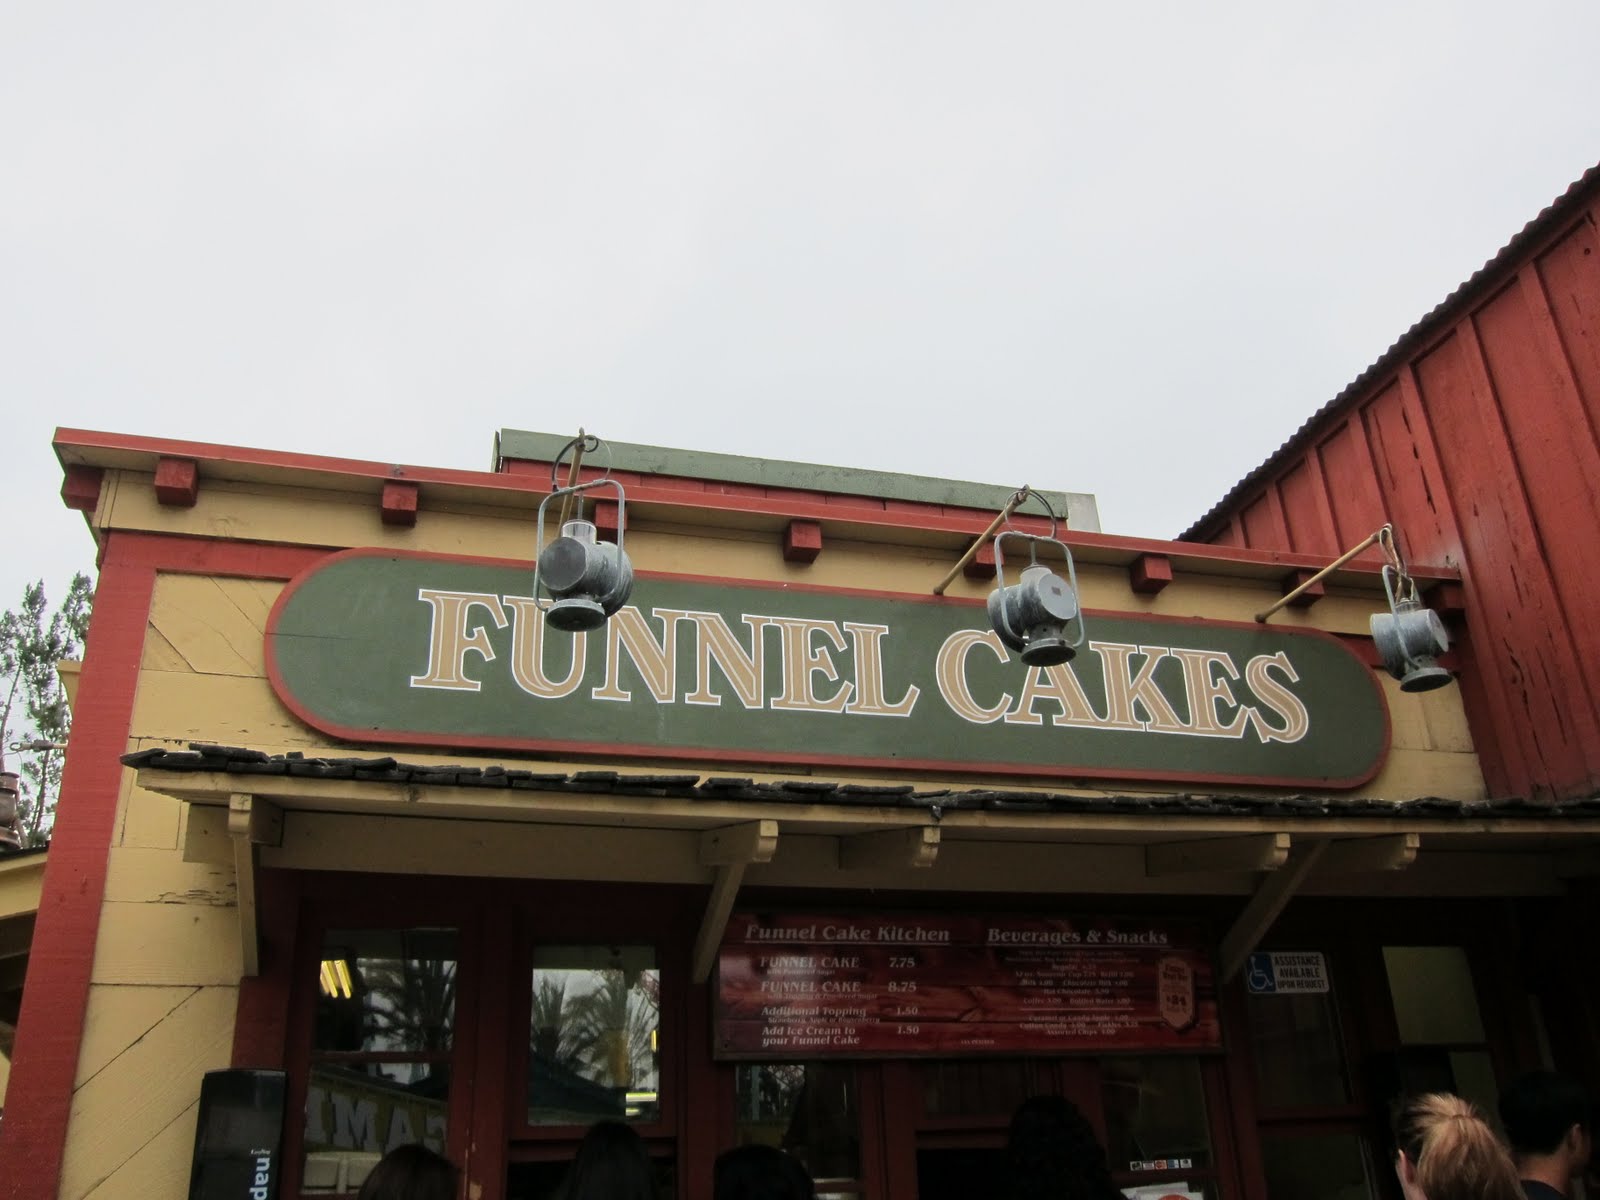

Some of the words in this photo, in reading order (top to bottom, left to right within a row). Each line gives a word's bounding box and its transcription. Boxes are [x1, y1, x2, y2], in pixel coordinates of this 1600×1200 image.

[410, 588, 920, 717] FUNNEL
[935, 628, 1309, 744] CAKES
[745, 924, 816, 940] Funnel
[822, 925, 871, 941] Cake
[877, 926, 950, 942] Kitchen
[987, 928, 1081, 945] Beverages
[1086, 929, 1102, 943] &
[1106, 930, 1168, 944] Snacks
[760, 957, 817, 968] FUNNEL
[821, 957, 859, 968] CAKE
[889, 957, 915, 968] 7.75
[1274, 956, 1320, 966] ASSISTANCE
[1280, 967, 1320, 978] AVAILABLE
[760, 981, 817, 992] FUNNEL
[821, 981, 861, 993] CAKE
[888, 982, 917, 992] 8.75
[1277, 980, 1295, 988] UPON
[1296, 980, 1325, 989] REQUEST
[761, 1006, 820, 1016] Additional
[823, 1006, 867, 1018] Topping
[896, 1006, 918, 1016] 1.50
[762, 1026, 784, 1035] Add
[787, 1026, 803, 1035] Ice
[806, 1026, 842, 1035] Cream
[844, 1026, 856, 1035] to
[897, 1026, 919, 1034] 1.50
[762, 1036, 788, 1046] your
[792, 1035, 830, 1045] Funnel
[833, 1036, 860, 1045] Cake
